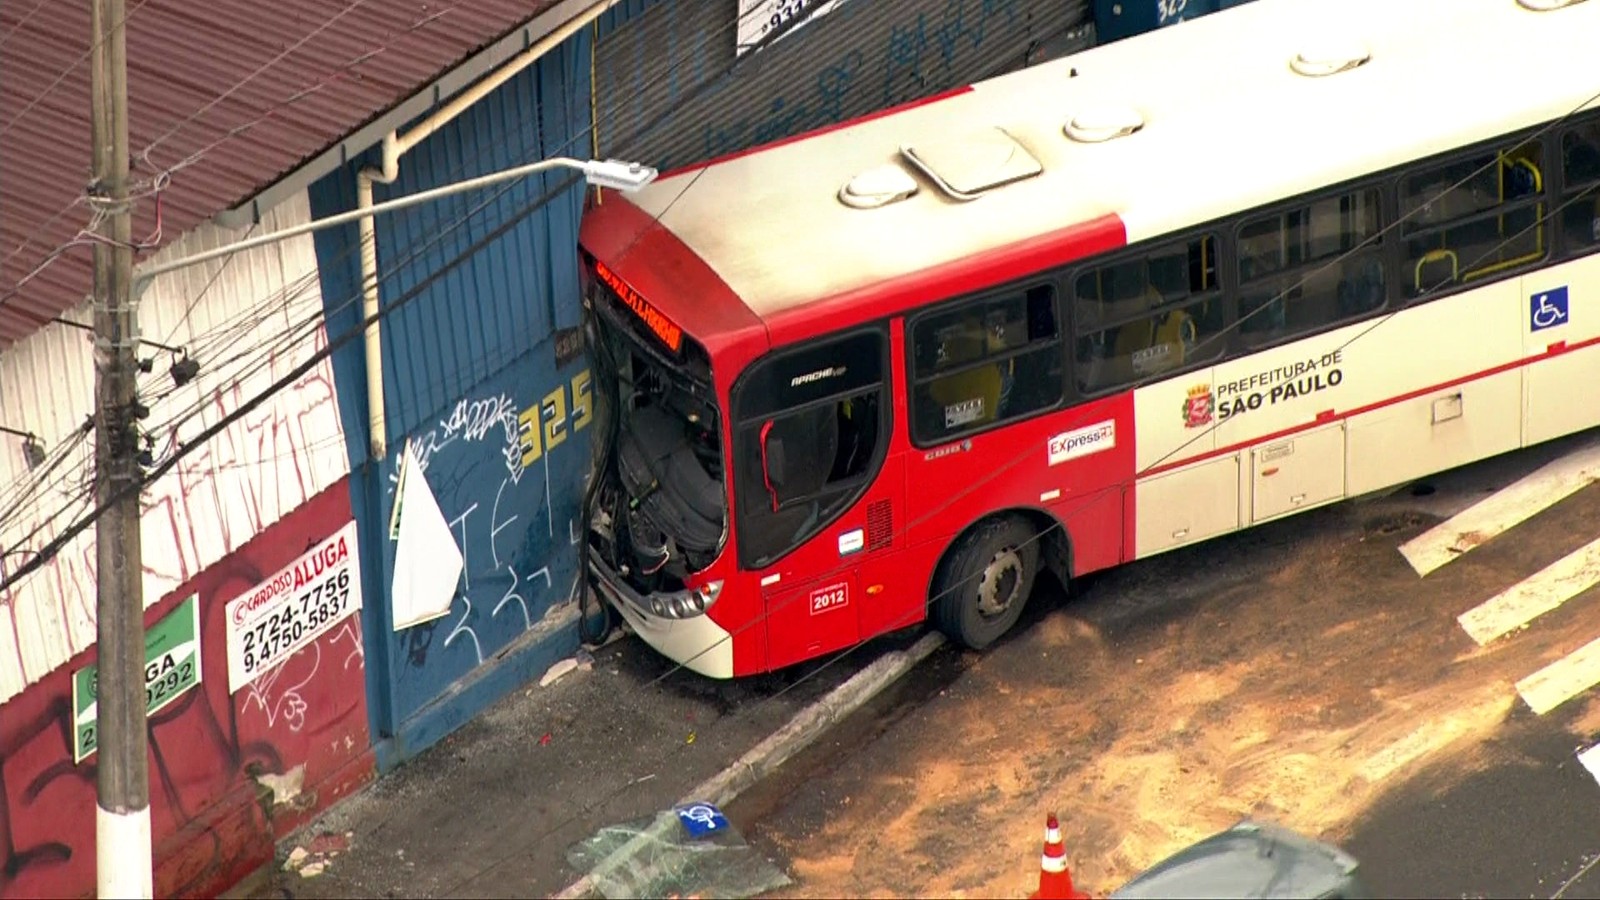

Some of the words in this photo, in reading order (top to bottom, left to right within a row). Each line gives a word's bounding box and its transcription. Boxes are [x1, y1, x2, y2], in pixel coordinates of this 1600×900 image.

[1217, 359, 1316, 398] PREFEITURA
[1321, 350, 1342, 368] DE
[1218, 394, 1262, 419] SÃO
[1270, 369, 1342, 404] PAULO
[518, 369, 592, 467] 325
[246, 572, 293, 610] CARDOSO
[293, 536, 348, 592] ALUGA
[814, 590, 845, 610] 2012
[243, 568, 350, 653] 2724-7756
[244, 589, 350, 673] 9.4750-5837
